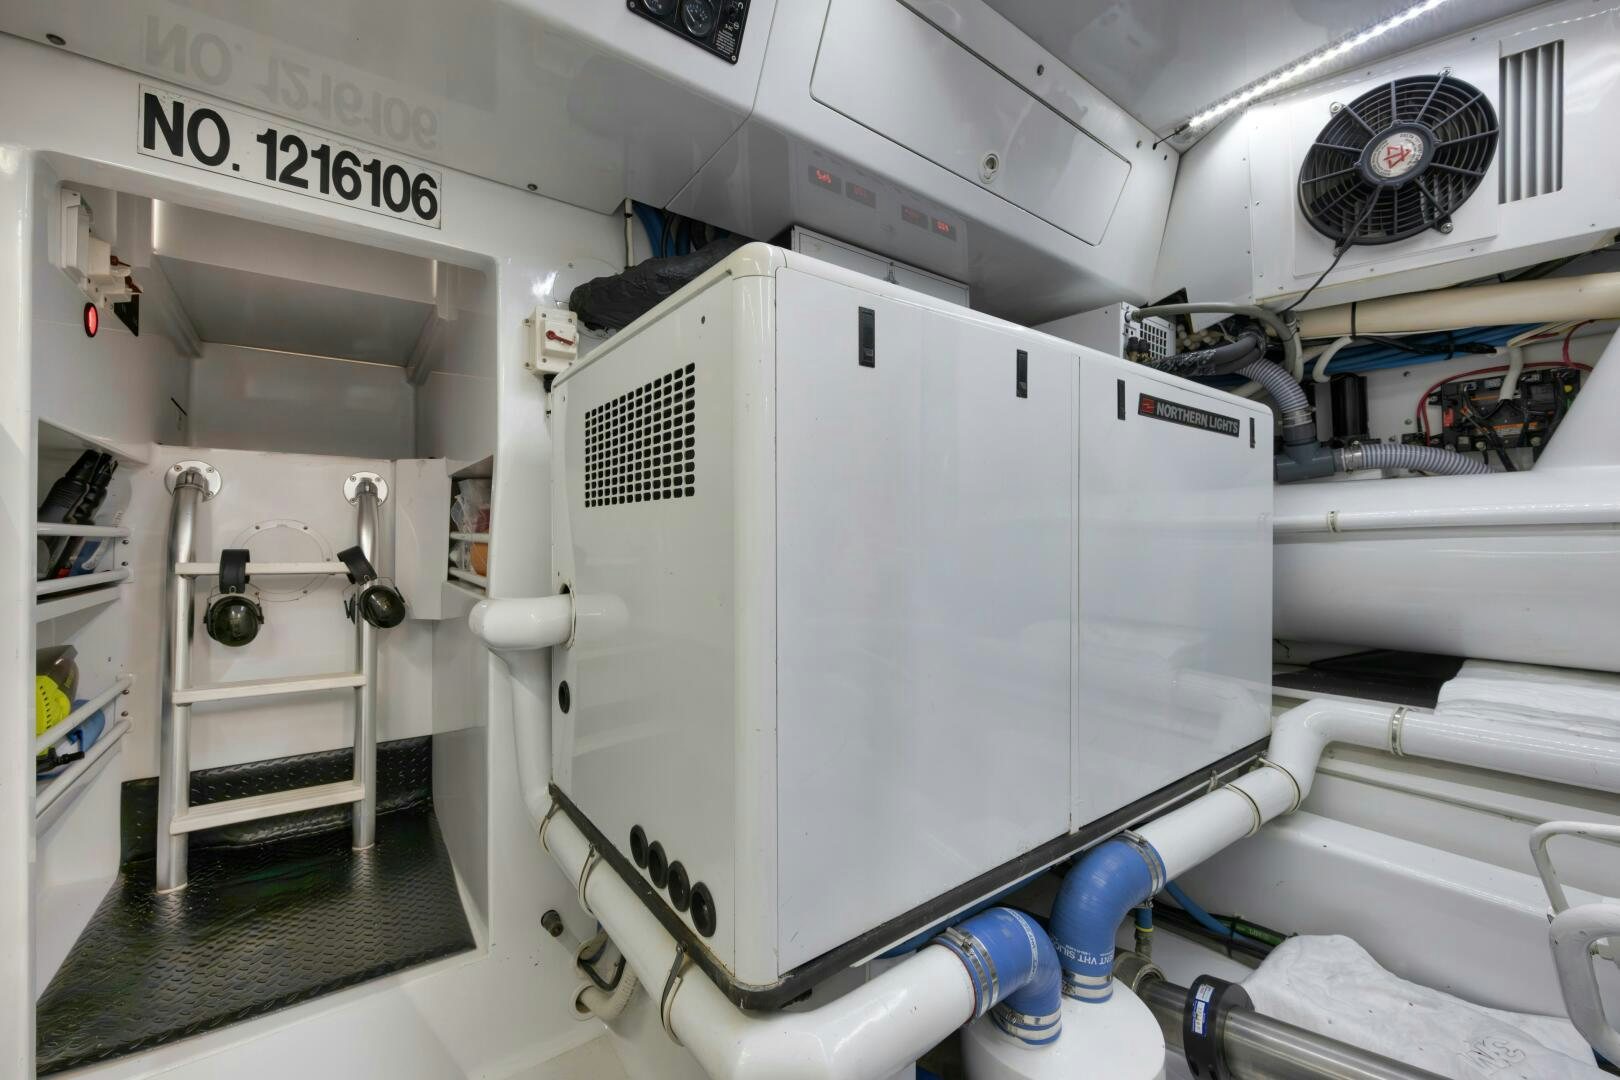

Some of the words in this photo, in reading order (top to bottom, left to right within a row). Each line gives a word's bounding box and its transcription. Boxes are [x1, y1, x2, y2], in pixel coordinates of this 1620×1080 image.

[143, 92, 240, 172] NO.
[256, 128, 438, 221] 1216106
[1156, 402, 1208, 428] NORTHERN
[1209, 416, 1239, 434] LIGHTS
[1078, 953, 1098, 965] VHT
